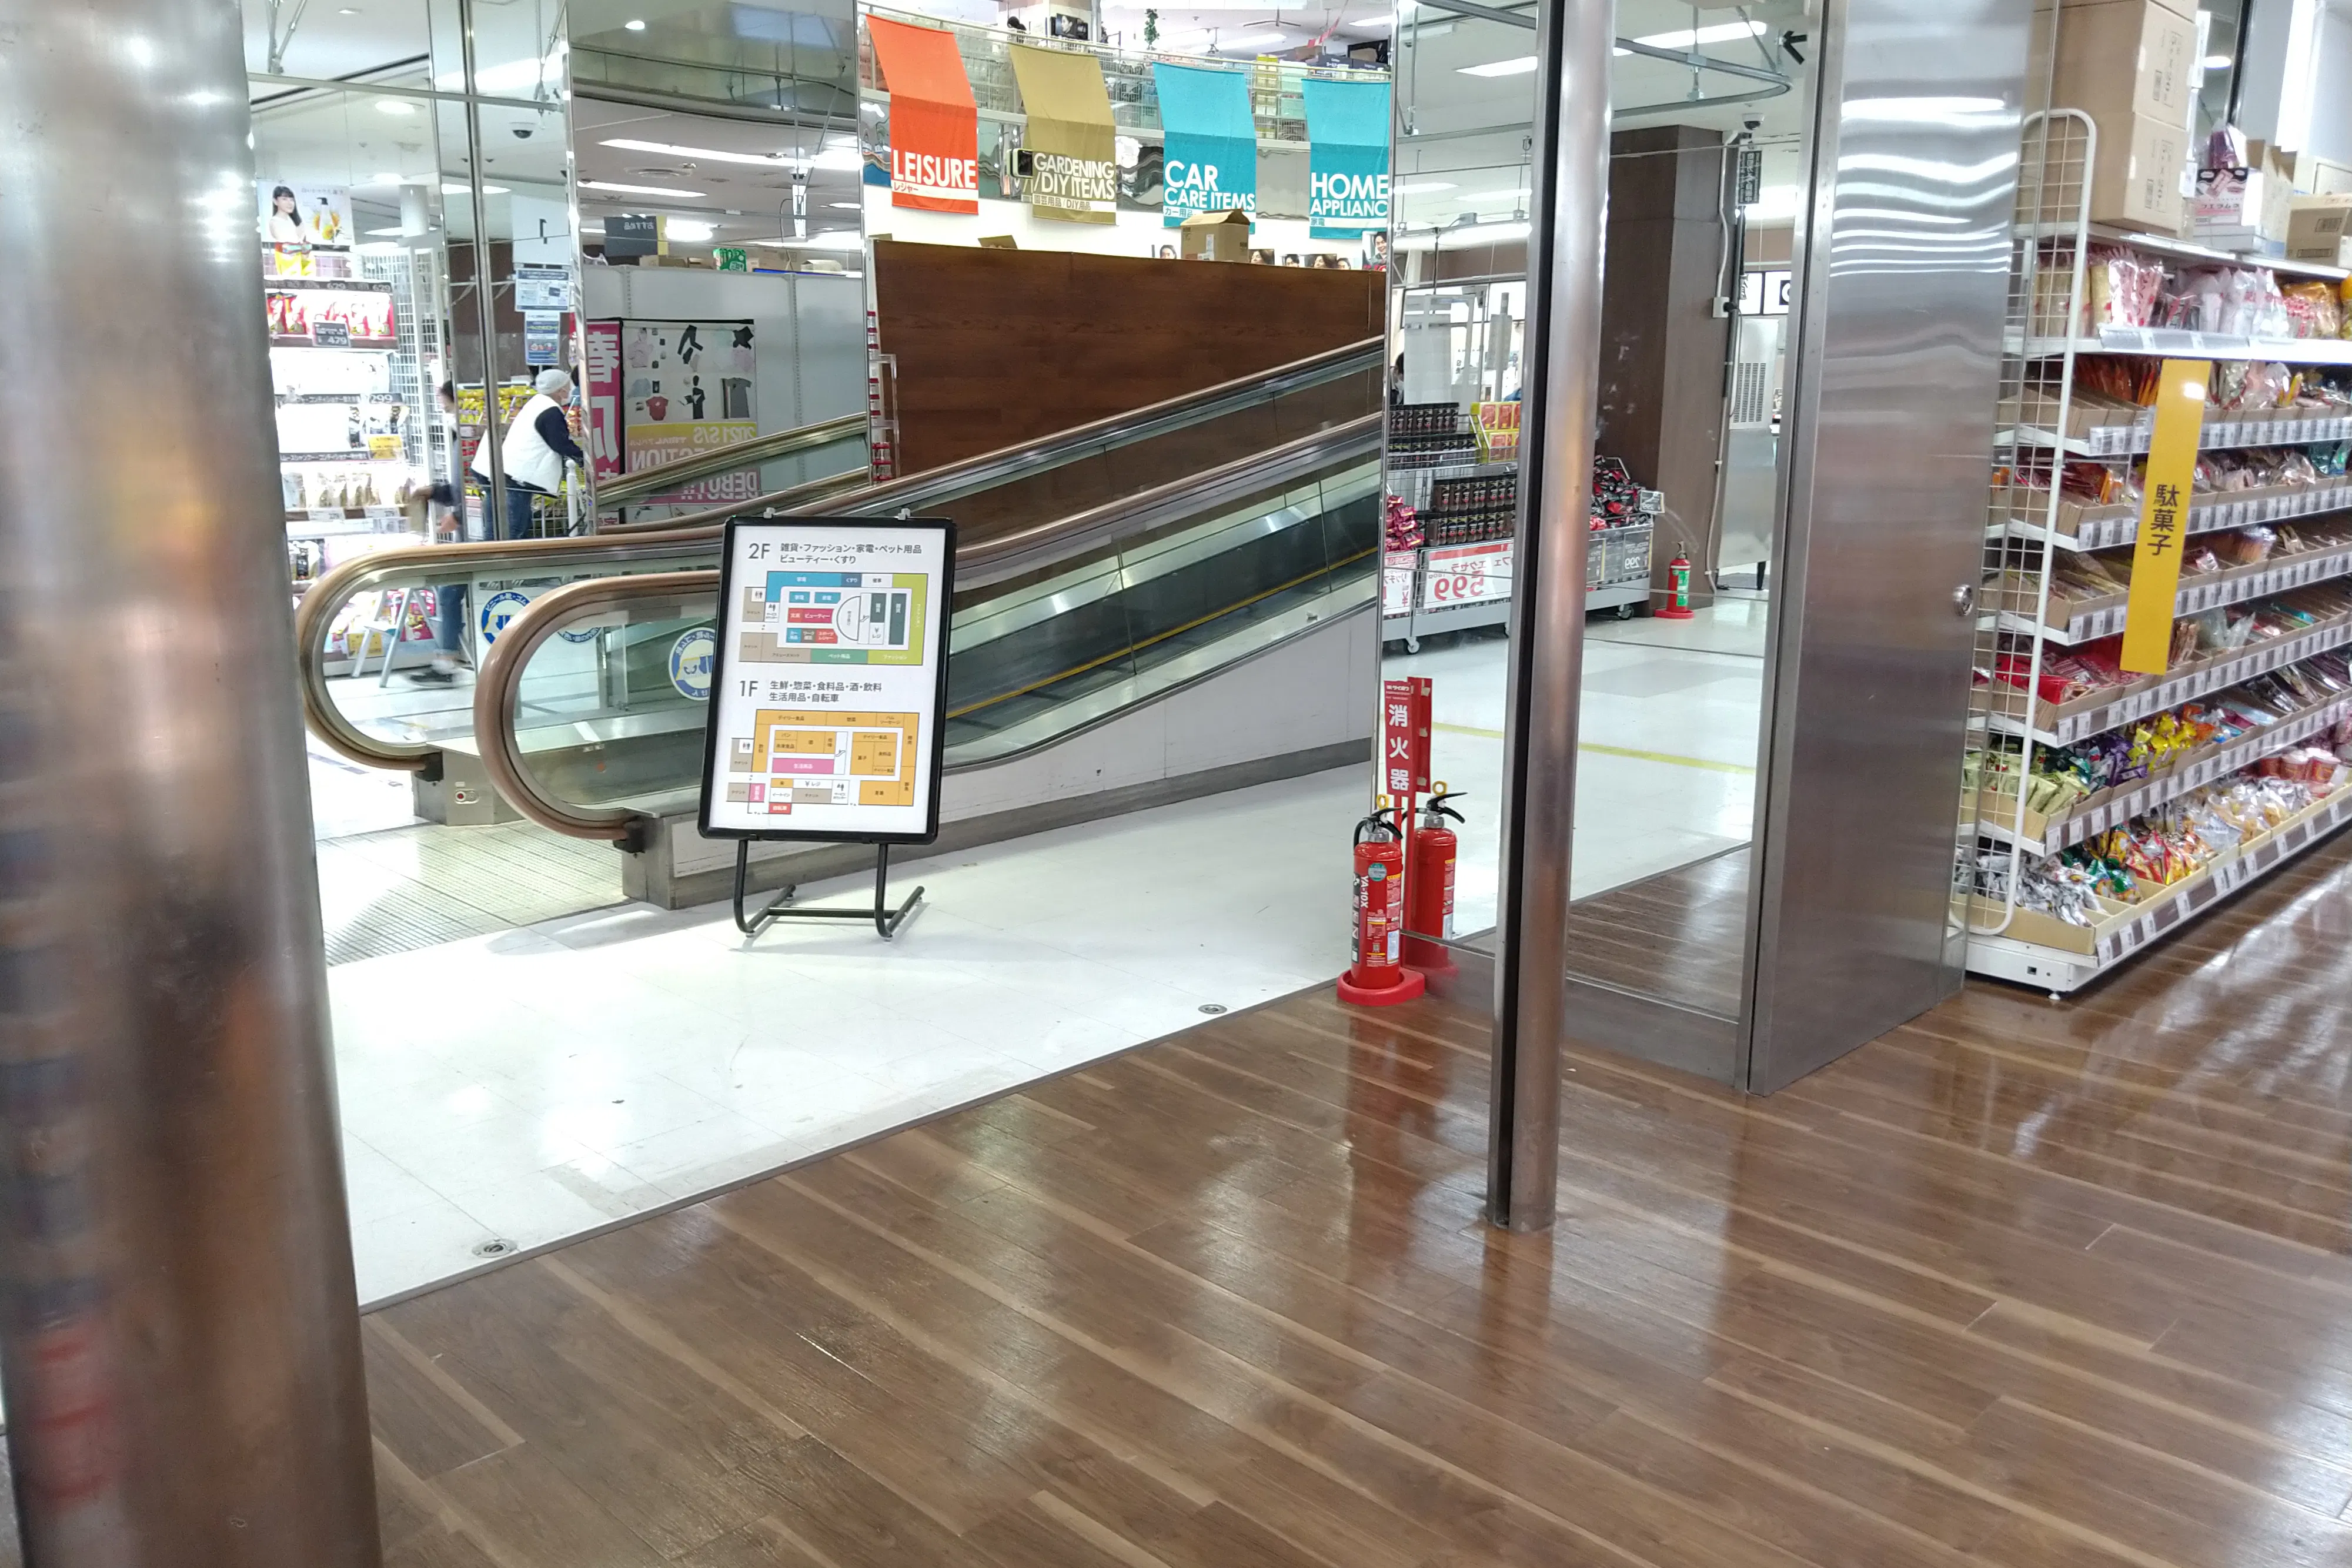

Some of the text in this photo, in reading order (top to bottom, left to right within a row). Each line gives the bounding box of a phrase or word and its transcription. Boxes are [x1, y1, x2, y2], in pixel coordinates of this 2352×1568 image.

[893, 150, 977, 189] LEISURE
[1034, 152, 1115, 178] GARDENING
[1034, 172, 1115, 200] /DIY ITEMS
[1165, 161, 1218, 192] CAR
[1311, 173, 1388, 199] HOME
[894, 182, 918, 193] レジャー
[1165, 187, 1255, 211] CARE ITEMS
[1310, 199, 1388, 217] APPLIANC
[1311, 218, 1325, 227] 家電
[2147, 484, 2180, 556] 駄菓子
[748, 543, 770, 559] 2F
[780, 543, 922, 554] 雑貨・ファッション・家電・ペット用品
[780, 554, 856, 564] ビューティー・くすり
[740, 680, 759, 697] 1F
[770, 680, 883, 692] 生鮮・惣菜・食料品・酒・飲料
[769, 693, 840, 703] 生活用品・自転車
[1389, 704, 1409, 791] 消火器
[1360, 875, 1369, 909] YA-10X
